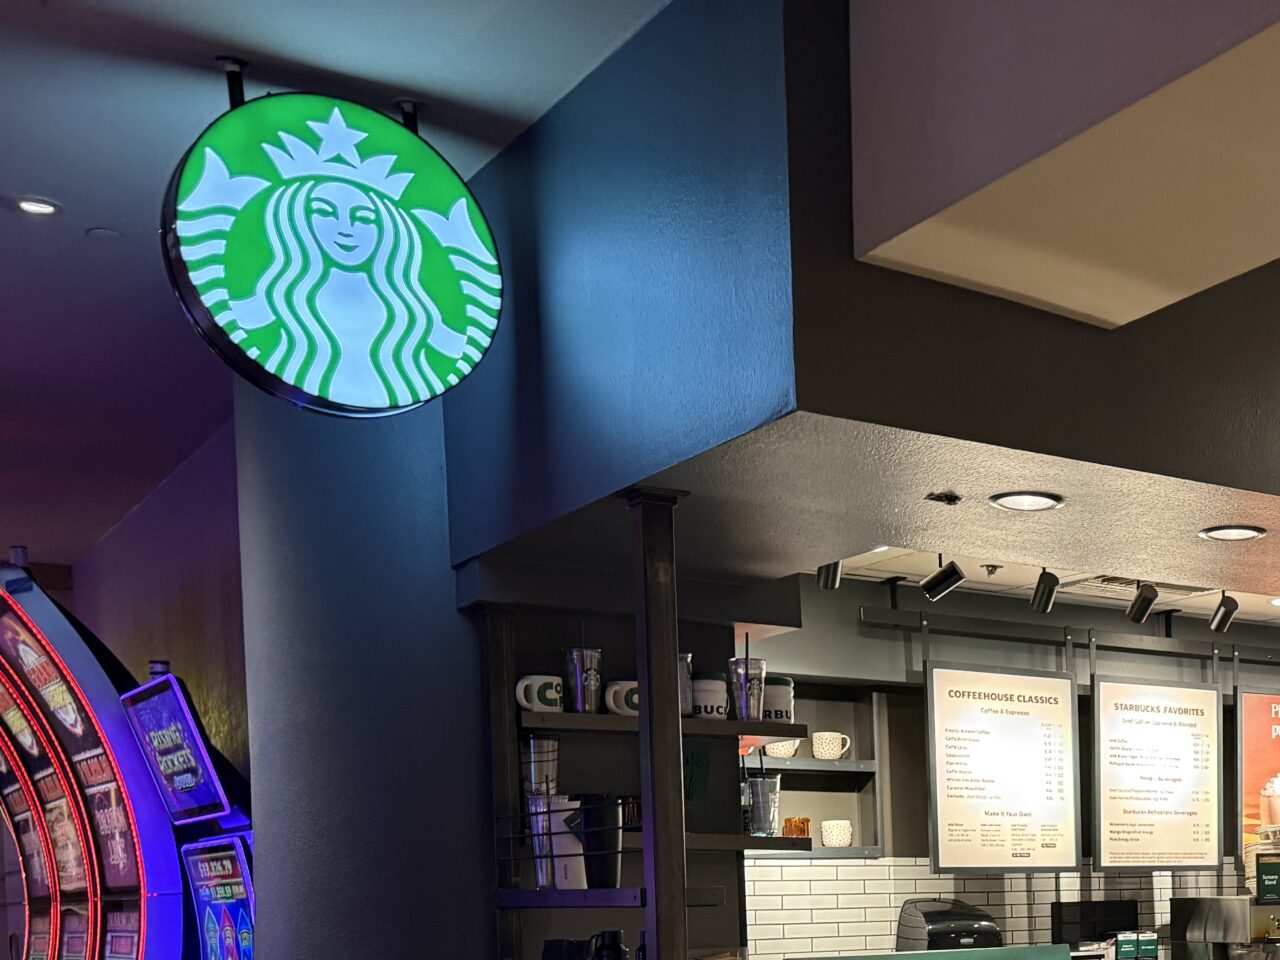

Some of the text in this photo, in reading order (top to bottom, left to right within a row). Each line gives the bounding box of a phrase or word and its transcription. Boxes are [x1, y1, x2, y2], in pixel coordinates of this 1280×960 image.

[948, 689, 1060, 705] COFFEEHOUSE CLASSICS
[1114, 703, 1205, 717] STARBUCKS FAVORITES
